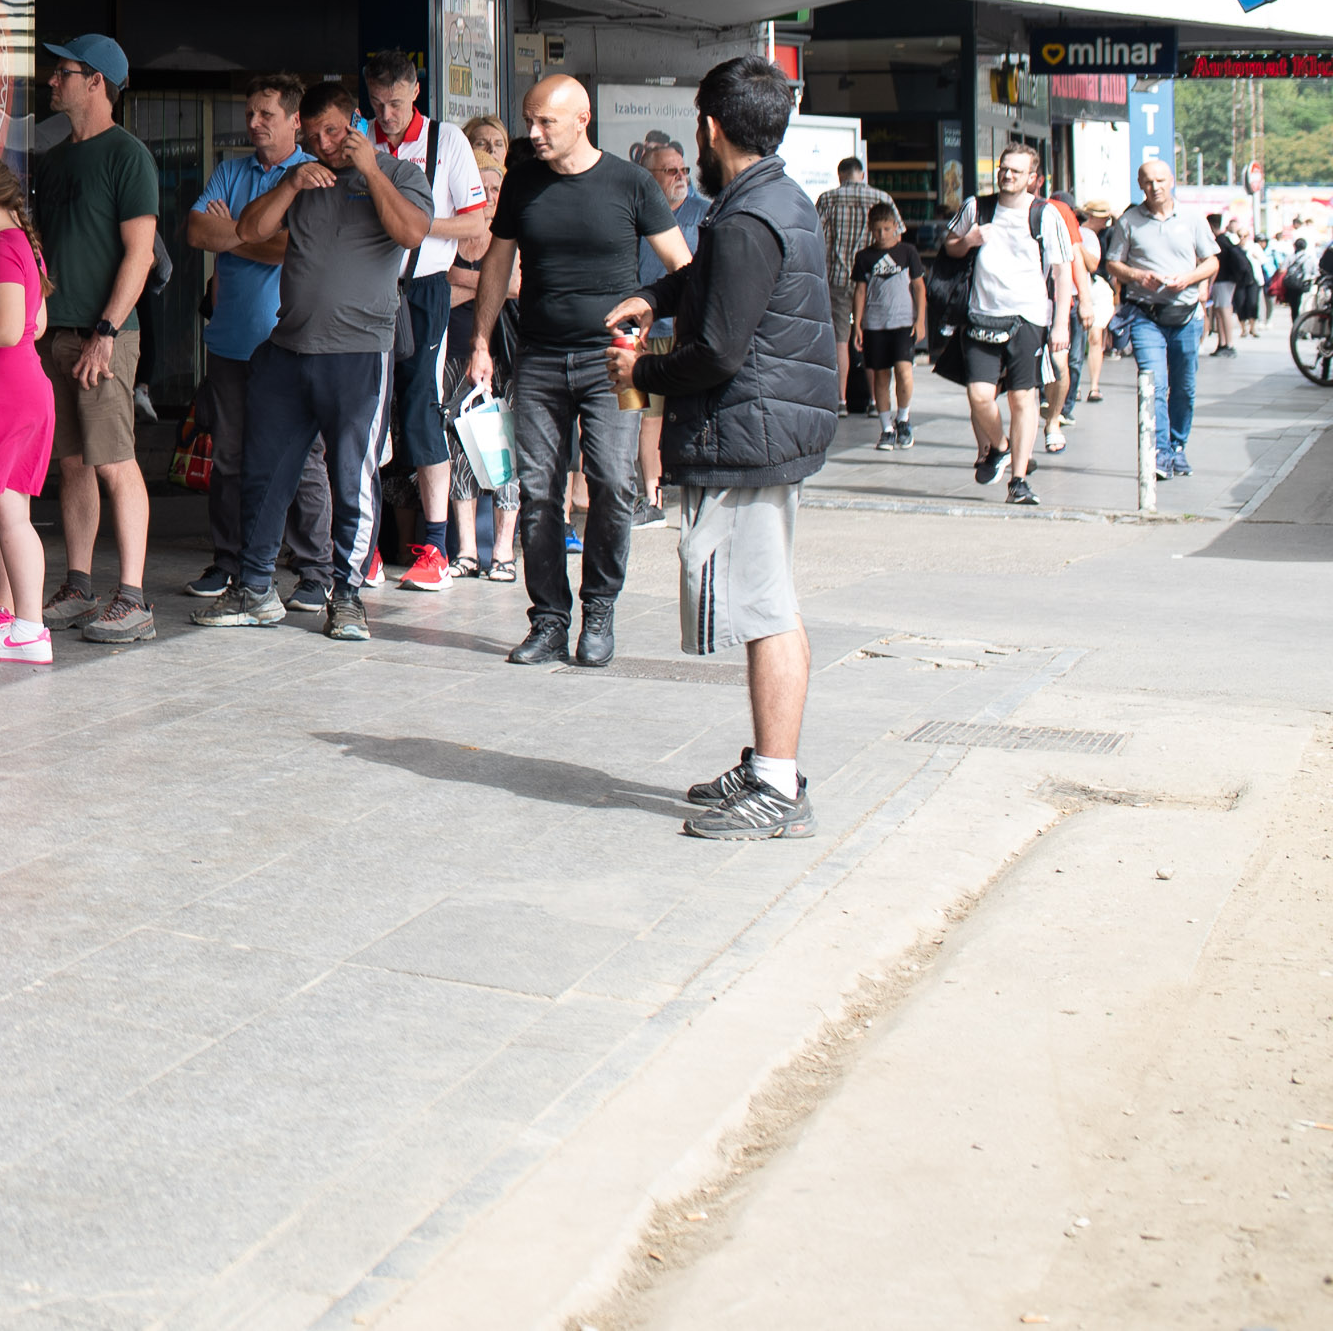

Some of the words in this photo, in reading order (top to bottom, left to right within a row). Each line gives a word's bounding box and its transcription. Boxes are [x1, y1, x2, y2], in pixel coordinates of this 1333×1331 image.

[1068, 37, 1163, 66] mlinar
[1192, 56, 1289, 77] Automat
[614, 102, 651, 115] Izaberi
